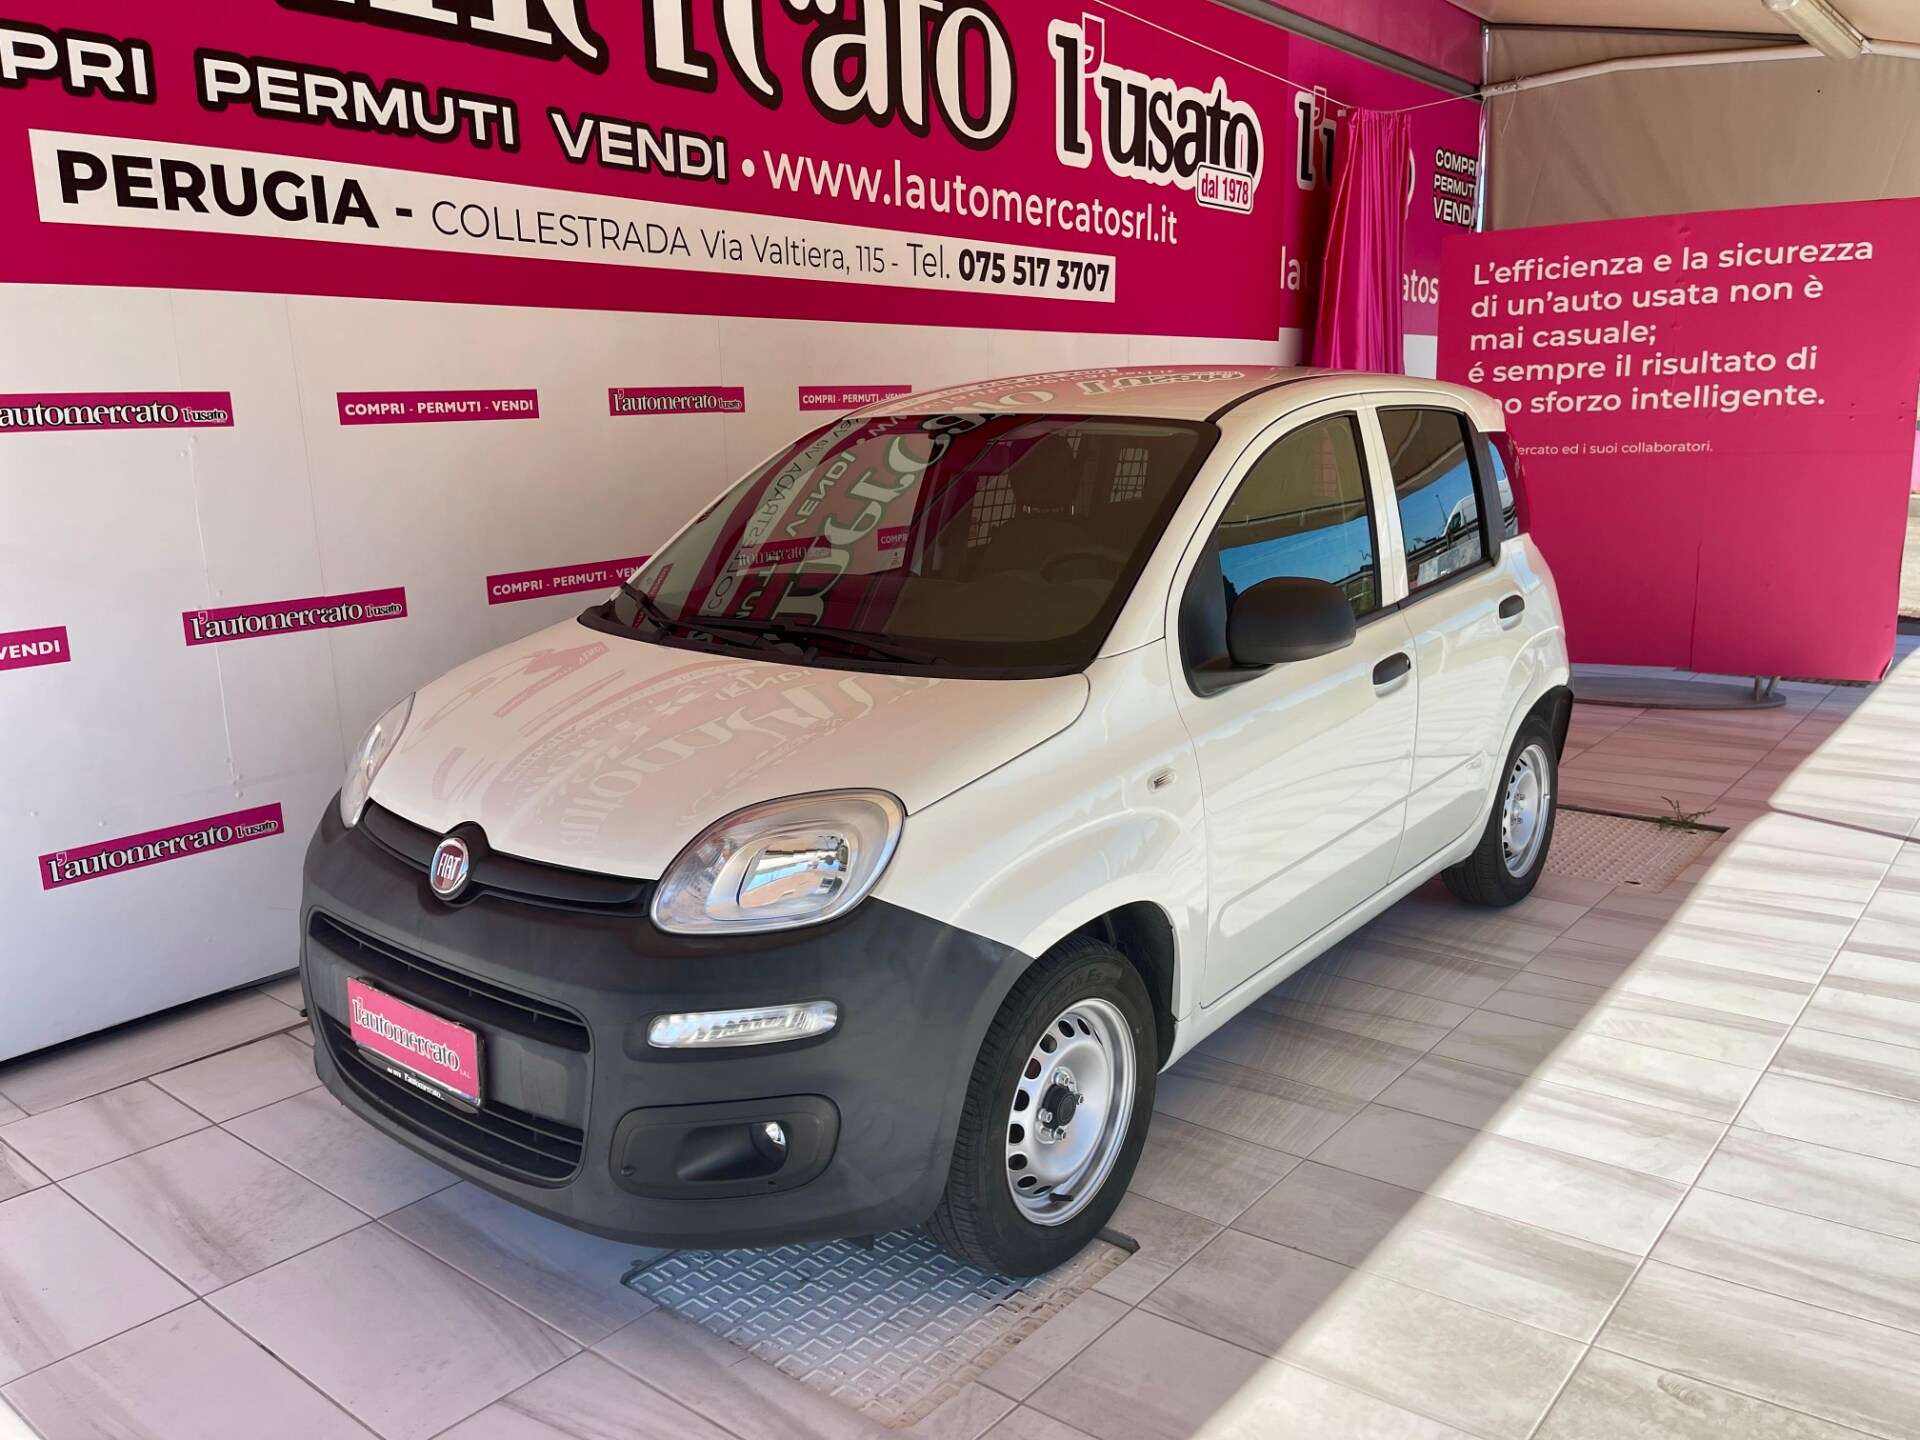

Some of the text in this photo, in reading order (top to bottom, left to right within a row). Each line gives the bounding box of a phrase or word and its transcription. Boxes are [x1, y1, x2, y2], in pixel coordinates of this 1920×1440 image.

[1048, 12, 1264, 190] l'usato
[203, 58, 515, 145] PERMUTI
[551, 113, 726, 180] VENDI
[763, 150, 1178, 245] www.lautomercatosrl.it
[1202, 173, 1249, 206] dal 1978
[1434, 174, 1475, 198] PERMUT
[57, 149, 380, 229] PERUGIA
[432, 200, 691, 257] COLLESTRADA
[701, 229, 743, 261] Via
[750, 233, 850, 275] Valtiera,
[855, 245, 885, 273] 115
[906, 242, 950, 279] Tel.
[959, 248, 1006, 283] 075
[1012, 256, 1051, 287] 517
[1056, 260, 1110, 292] 3707
[1473, 240, 1873, 286] L'efficienza e la sicurezza
[1471, 275, 1824, 318] di un'auto usata non è
[1470, 320, 1656, 351] mai casuale;
[1468, 345, 1818, 385] é sempre il risultato di
[345, 402, 405, 416] COMPRI
[417, 401, 481, 414] PERMUTI
[492, 399, 533, 412] VENDI
[612, 388, 717, 412] l'automercato
[802, 393, 837, 404] COMPRI
[843, 393, 880, 404] PERMUTI
[1530, 391, 1622, 414] sforzo
[1631, 383, 1826, 413] intelligente.
[1517, 444, 1558, 455] ercato
[1562, 443, 1580, 455] ed
[1589, 442, 1618, 455] suoi
[1621, 440, 1713, 454] collaboratori.
[493, 579, 543, 596] COMPRI
[553, 570, 607, 588] PERMUTI
[616, 566, 641, 579] VEN
[48, 819, 279, 883] l'automercato l'usato
[437, 852, 462, 881] FIAT
[352, 996, 461, 1072] l'automercato
